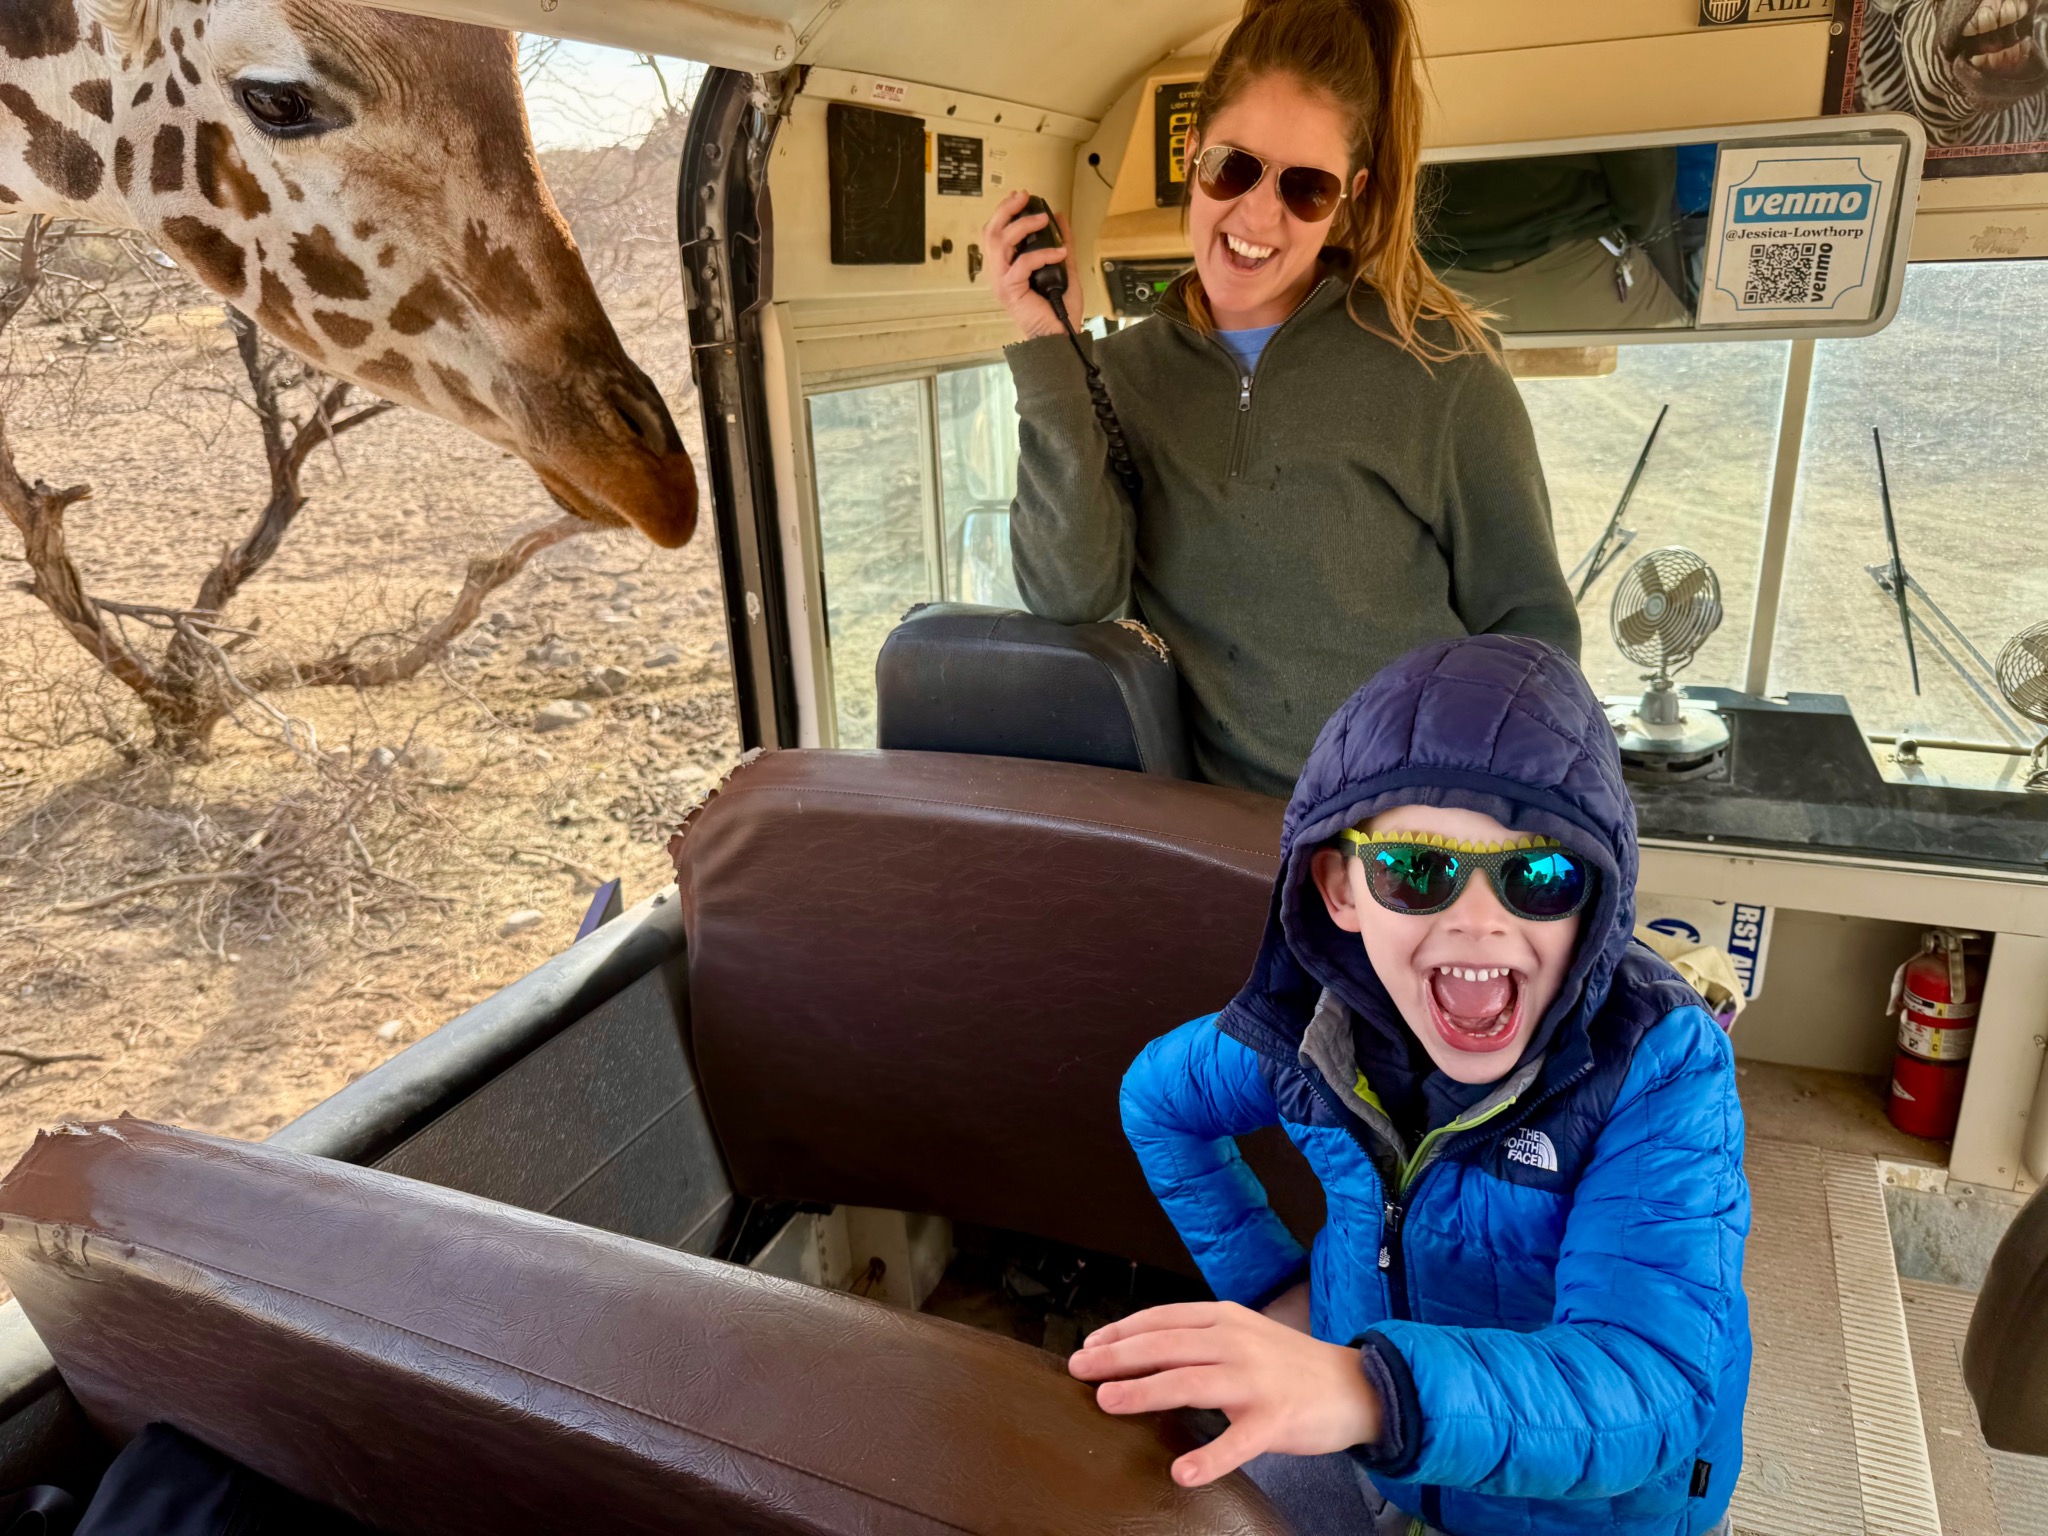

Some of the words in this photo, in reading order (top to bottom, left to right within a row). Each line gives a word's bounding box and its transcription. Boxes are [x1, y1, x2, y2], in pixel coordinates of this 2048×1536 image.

[1743, 191, 1862, 216] venmo
[1725, 226, 1864, 241] @Jessica-Lowthorp
[1811, 242, 1833, 302] venmo
[1519, 1127, 1540, 1141] THE
[1501, 1137, 1540, 1154] NORTH
[1507, 1149, 1538, 1167] FACE
